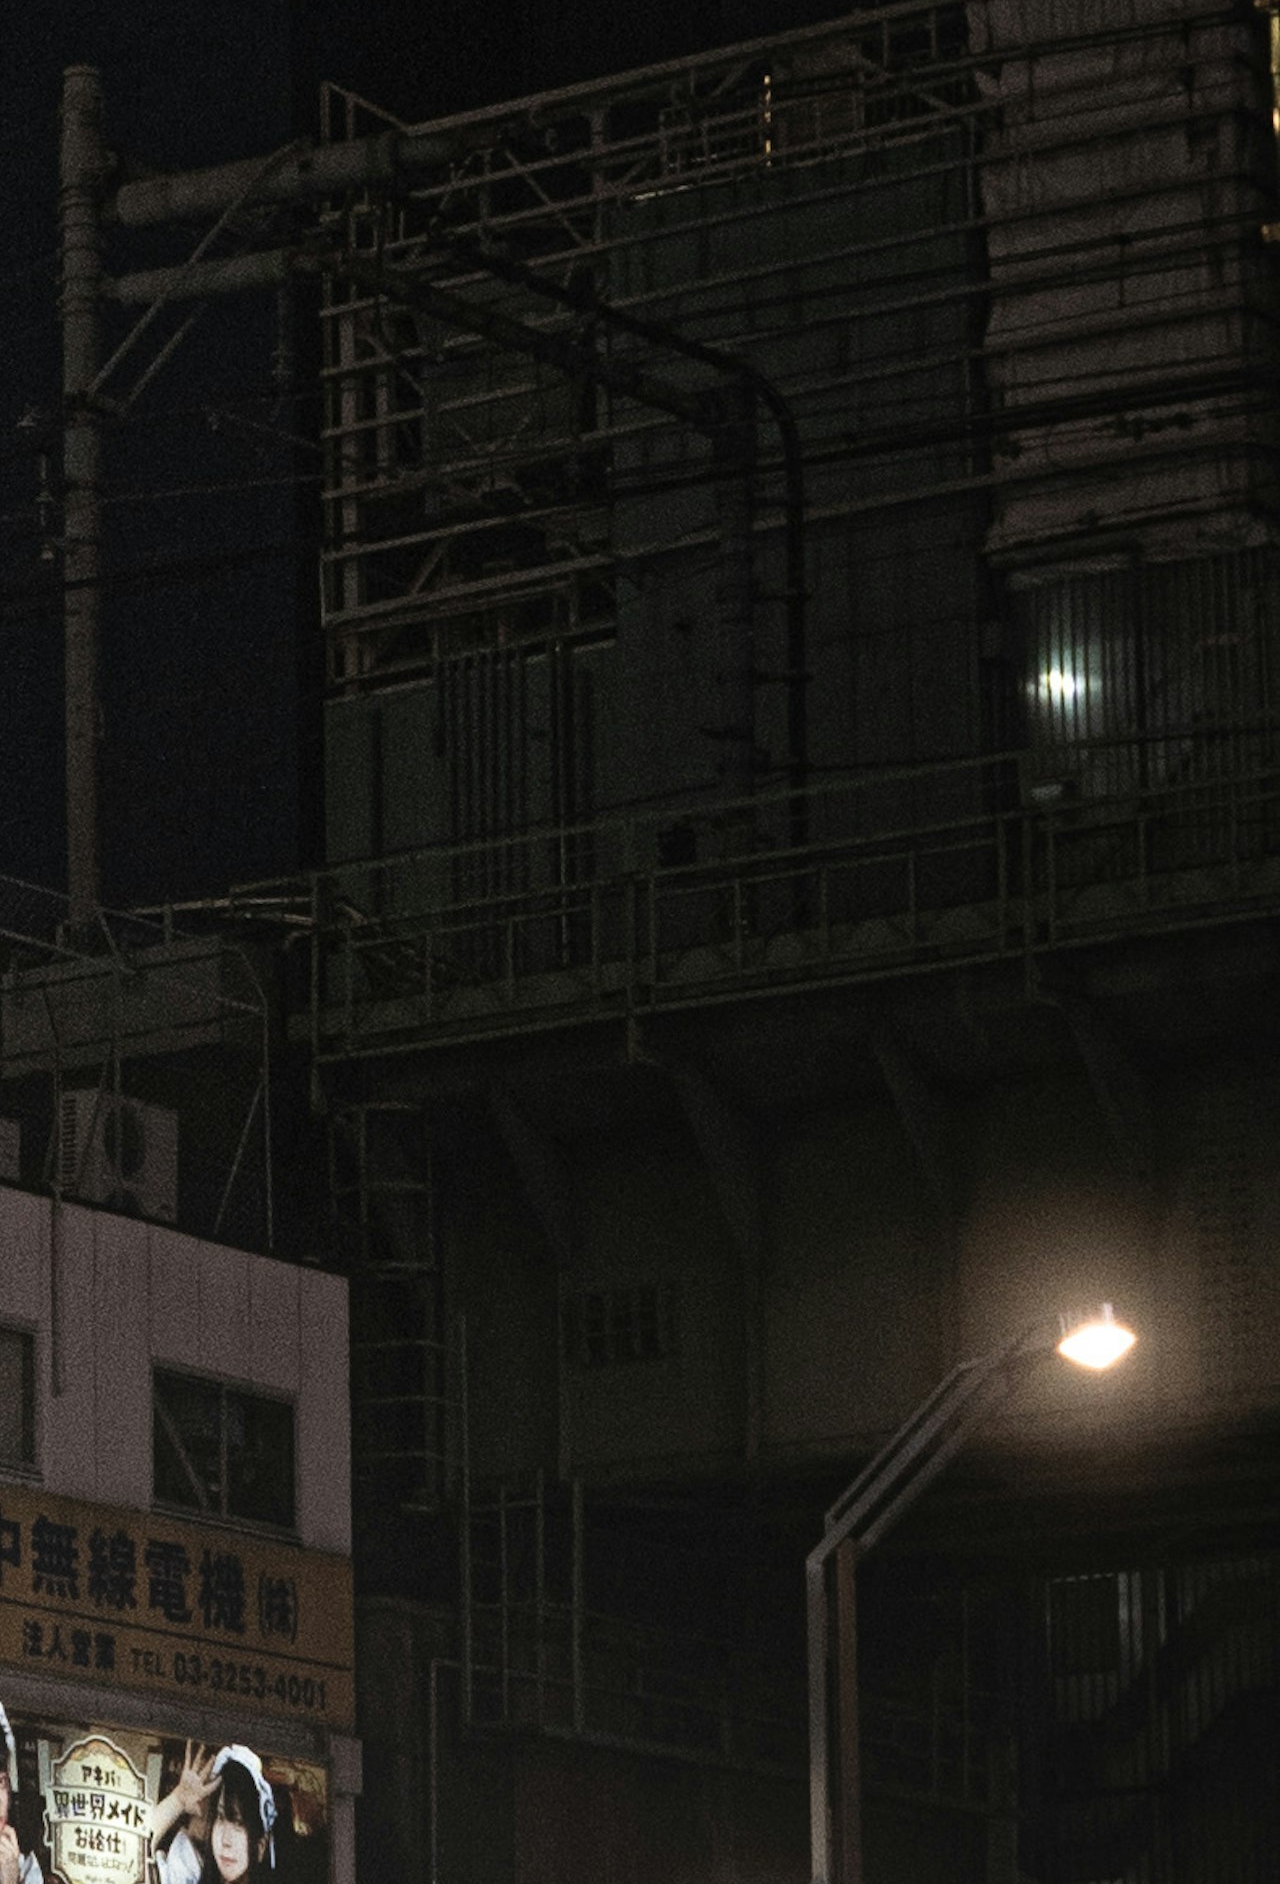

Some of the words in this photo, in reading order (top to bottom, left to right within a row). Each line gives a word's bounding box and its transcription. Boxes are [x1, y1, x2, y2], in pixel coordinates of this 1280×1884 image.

[130, 1648, 166, 1678] TEL
[53, 1790, 147, 1828] 異世界メイド
